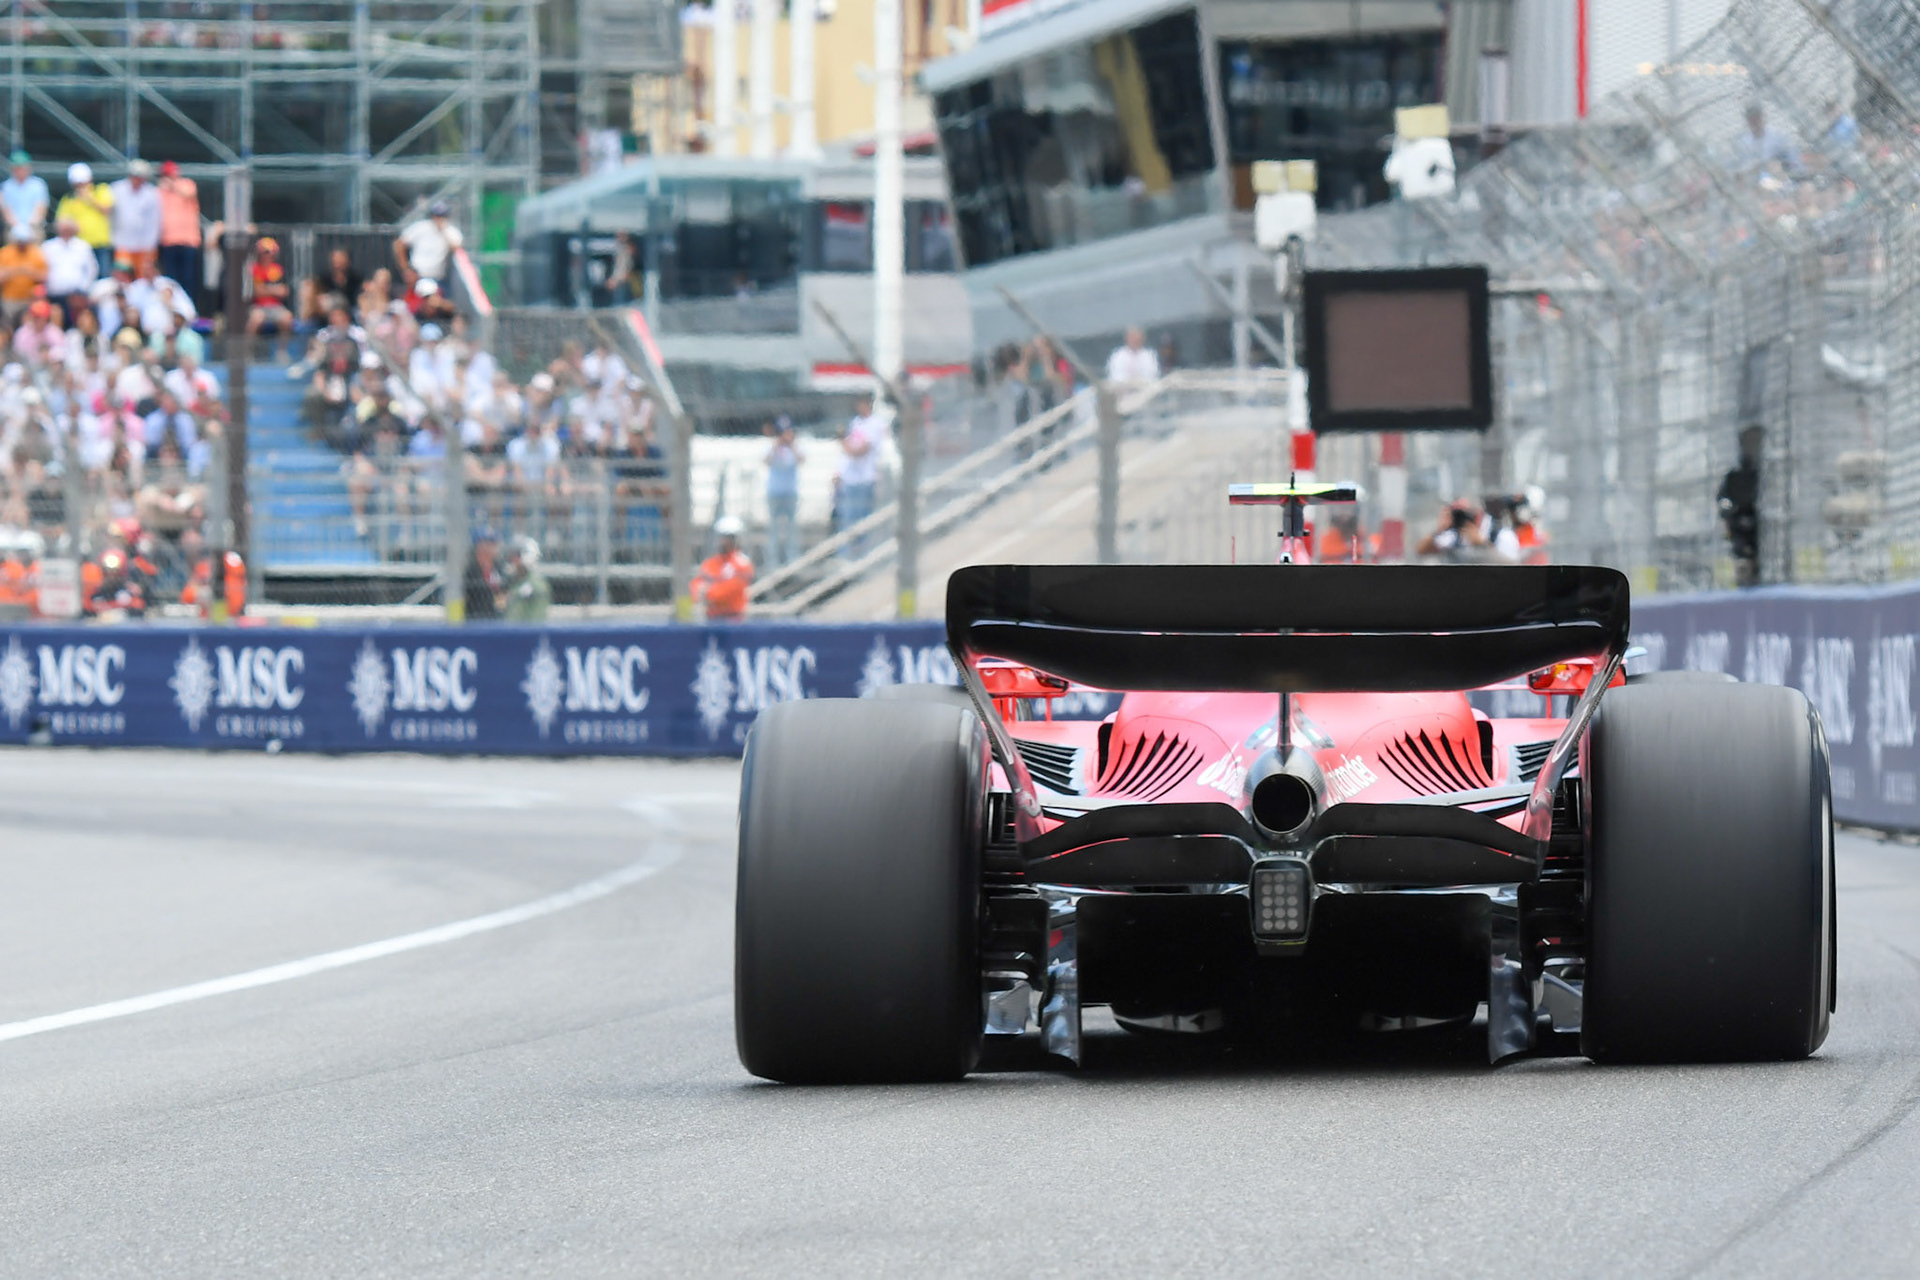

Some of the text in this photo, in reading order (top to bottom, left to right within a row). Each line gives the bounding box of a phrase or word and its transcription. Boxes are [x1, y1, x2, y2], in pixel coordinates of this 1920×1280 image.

[37, 644, 126, 706] MSC
[215, 645, 304, 710] MSC
[391, 646, 477, 711] MSC
[564, 644, 650, 713] MSC
[734, 645, 817, 712] MSC
[899, 644, 959, 685] MS
